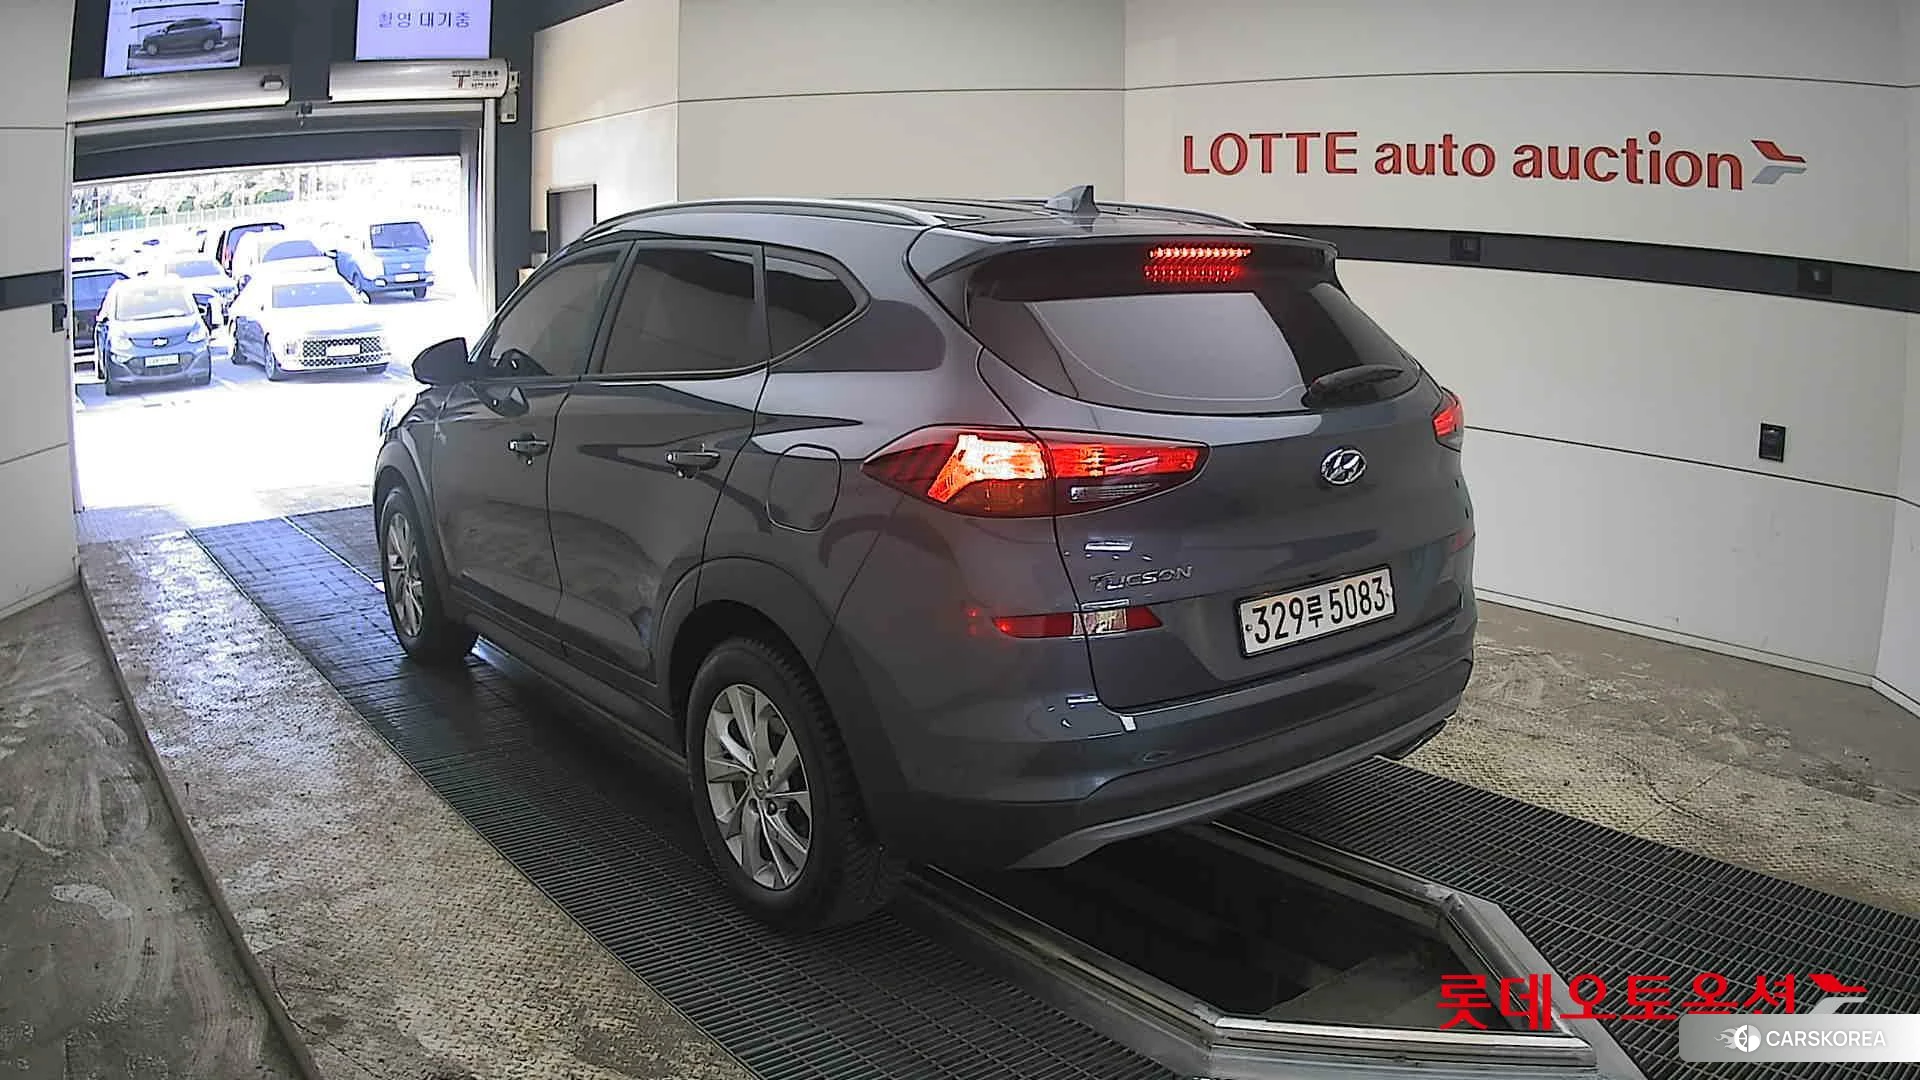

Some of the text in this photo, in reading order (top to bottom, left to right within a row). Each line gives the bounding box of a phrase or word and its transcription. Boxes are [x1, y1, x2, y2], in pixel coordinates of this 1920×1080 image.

[419, 11, 471, 29] 대기중
[1184, 131, 1744, 190] LOTTE auto auction
[1088, 565, 1193, 592] TUCSON
